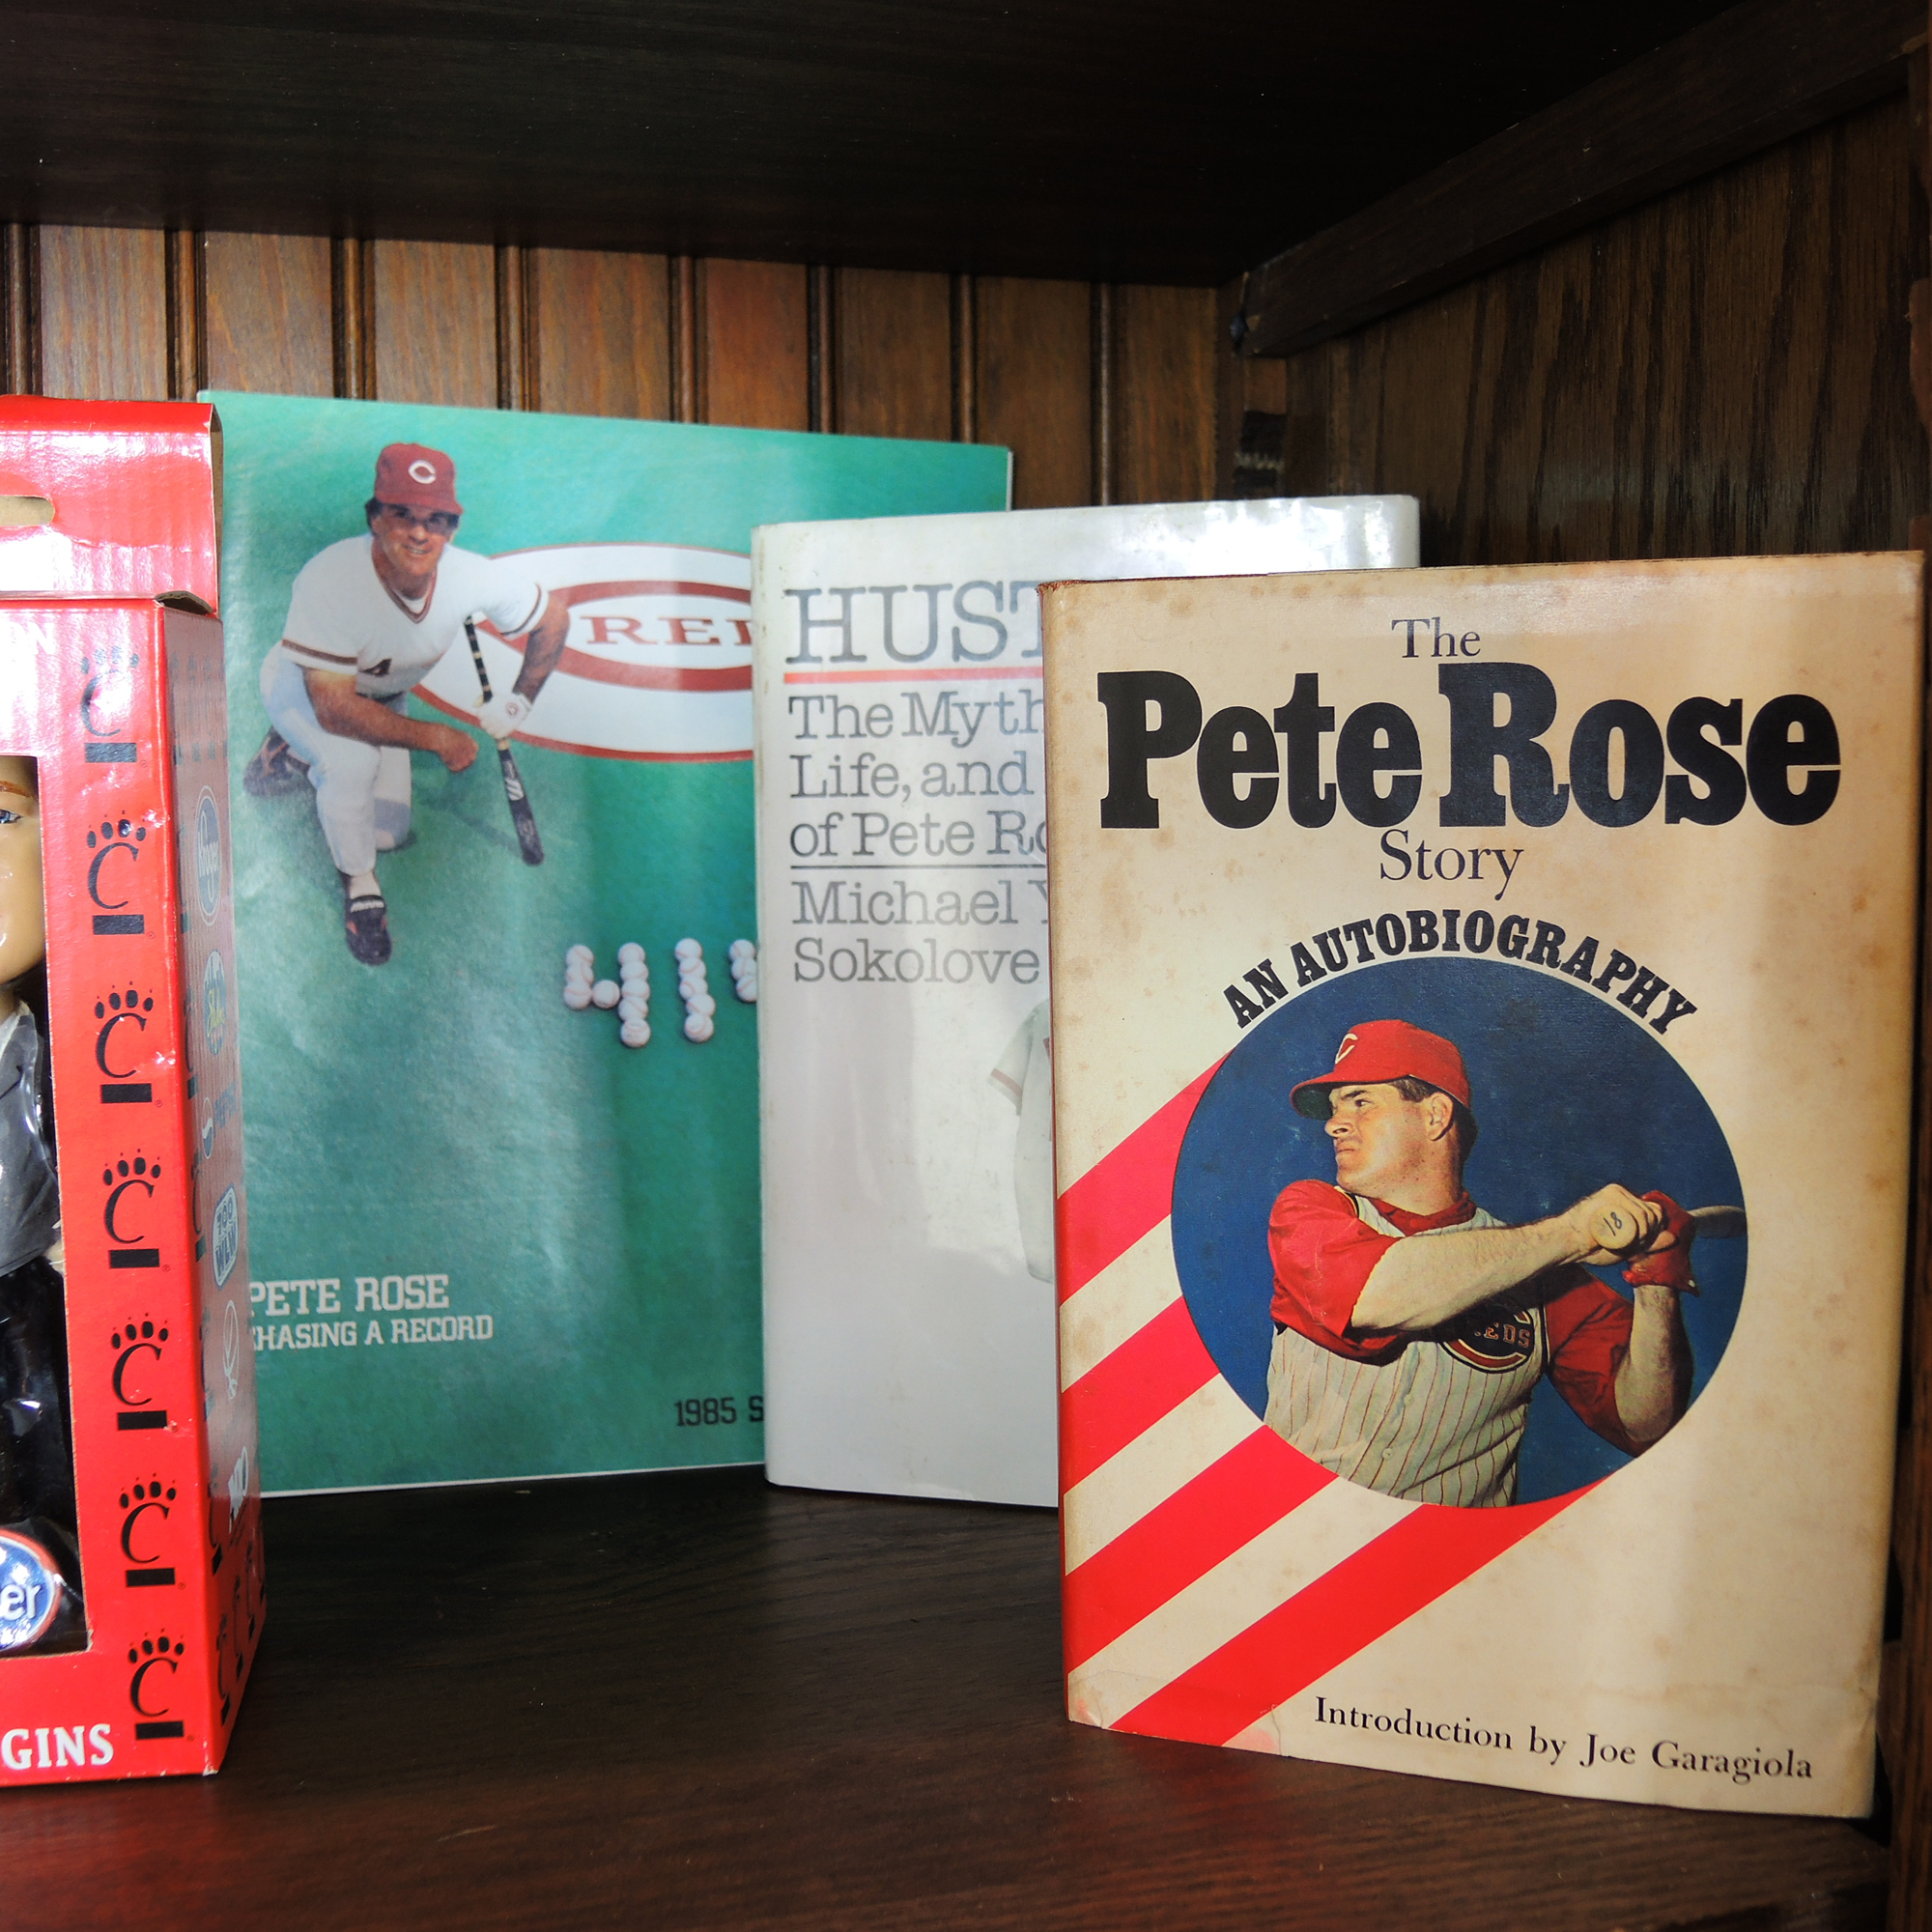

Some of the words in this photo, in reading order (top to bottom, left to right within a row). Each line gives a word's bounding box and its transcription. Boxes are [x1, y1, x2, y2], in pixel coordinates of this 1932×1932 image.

[1391, 616, 1482, 660] The
[787, 695, 894, 739] The
[900, 688, 1044, 749] Myth
[1097, 670, 1423, 830] Pete
[1437, 662, 1841, 829] Rose
[789, 753, 911, 803] Life,
[920, 751, 1035, 797] and
[789, 812, 843, 857] of
[851, 812, 975, 857] Pete
[1379, 829, 1525, 901] Story
[790, 880, 1018, 926] Michael
[794, 937, 1040, 985] Sokolove
[1222, 956, 1294, 1030] AN
[1291, 909, 1698, 1035] AUTOBIOGRAPHY
[1603, 1211, 1623, 1236] 18
[249, 1278, 341, 1318] PETE
[355, 1273, 450, 1312] ROSE
[253, 1321, 357, 1351] HASING
[363, 1320, 384, 1346] A
[390, 1314, 495, 1344] RECORD
[1474, 1321, 1531, 1349] EDS
[673, 1396, 738, 1427] 1985
[1, 1722, 115, 1771] GINS
[1315, 1695, 1513, 1751] Introduction
[1528, 1725, 1568, 1766] by
[1578, 1732, 1636, 1769] Joe
[1652, 1739, 1813, 1785] Garagiola
